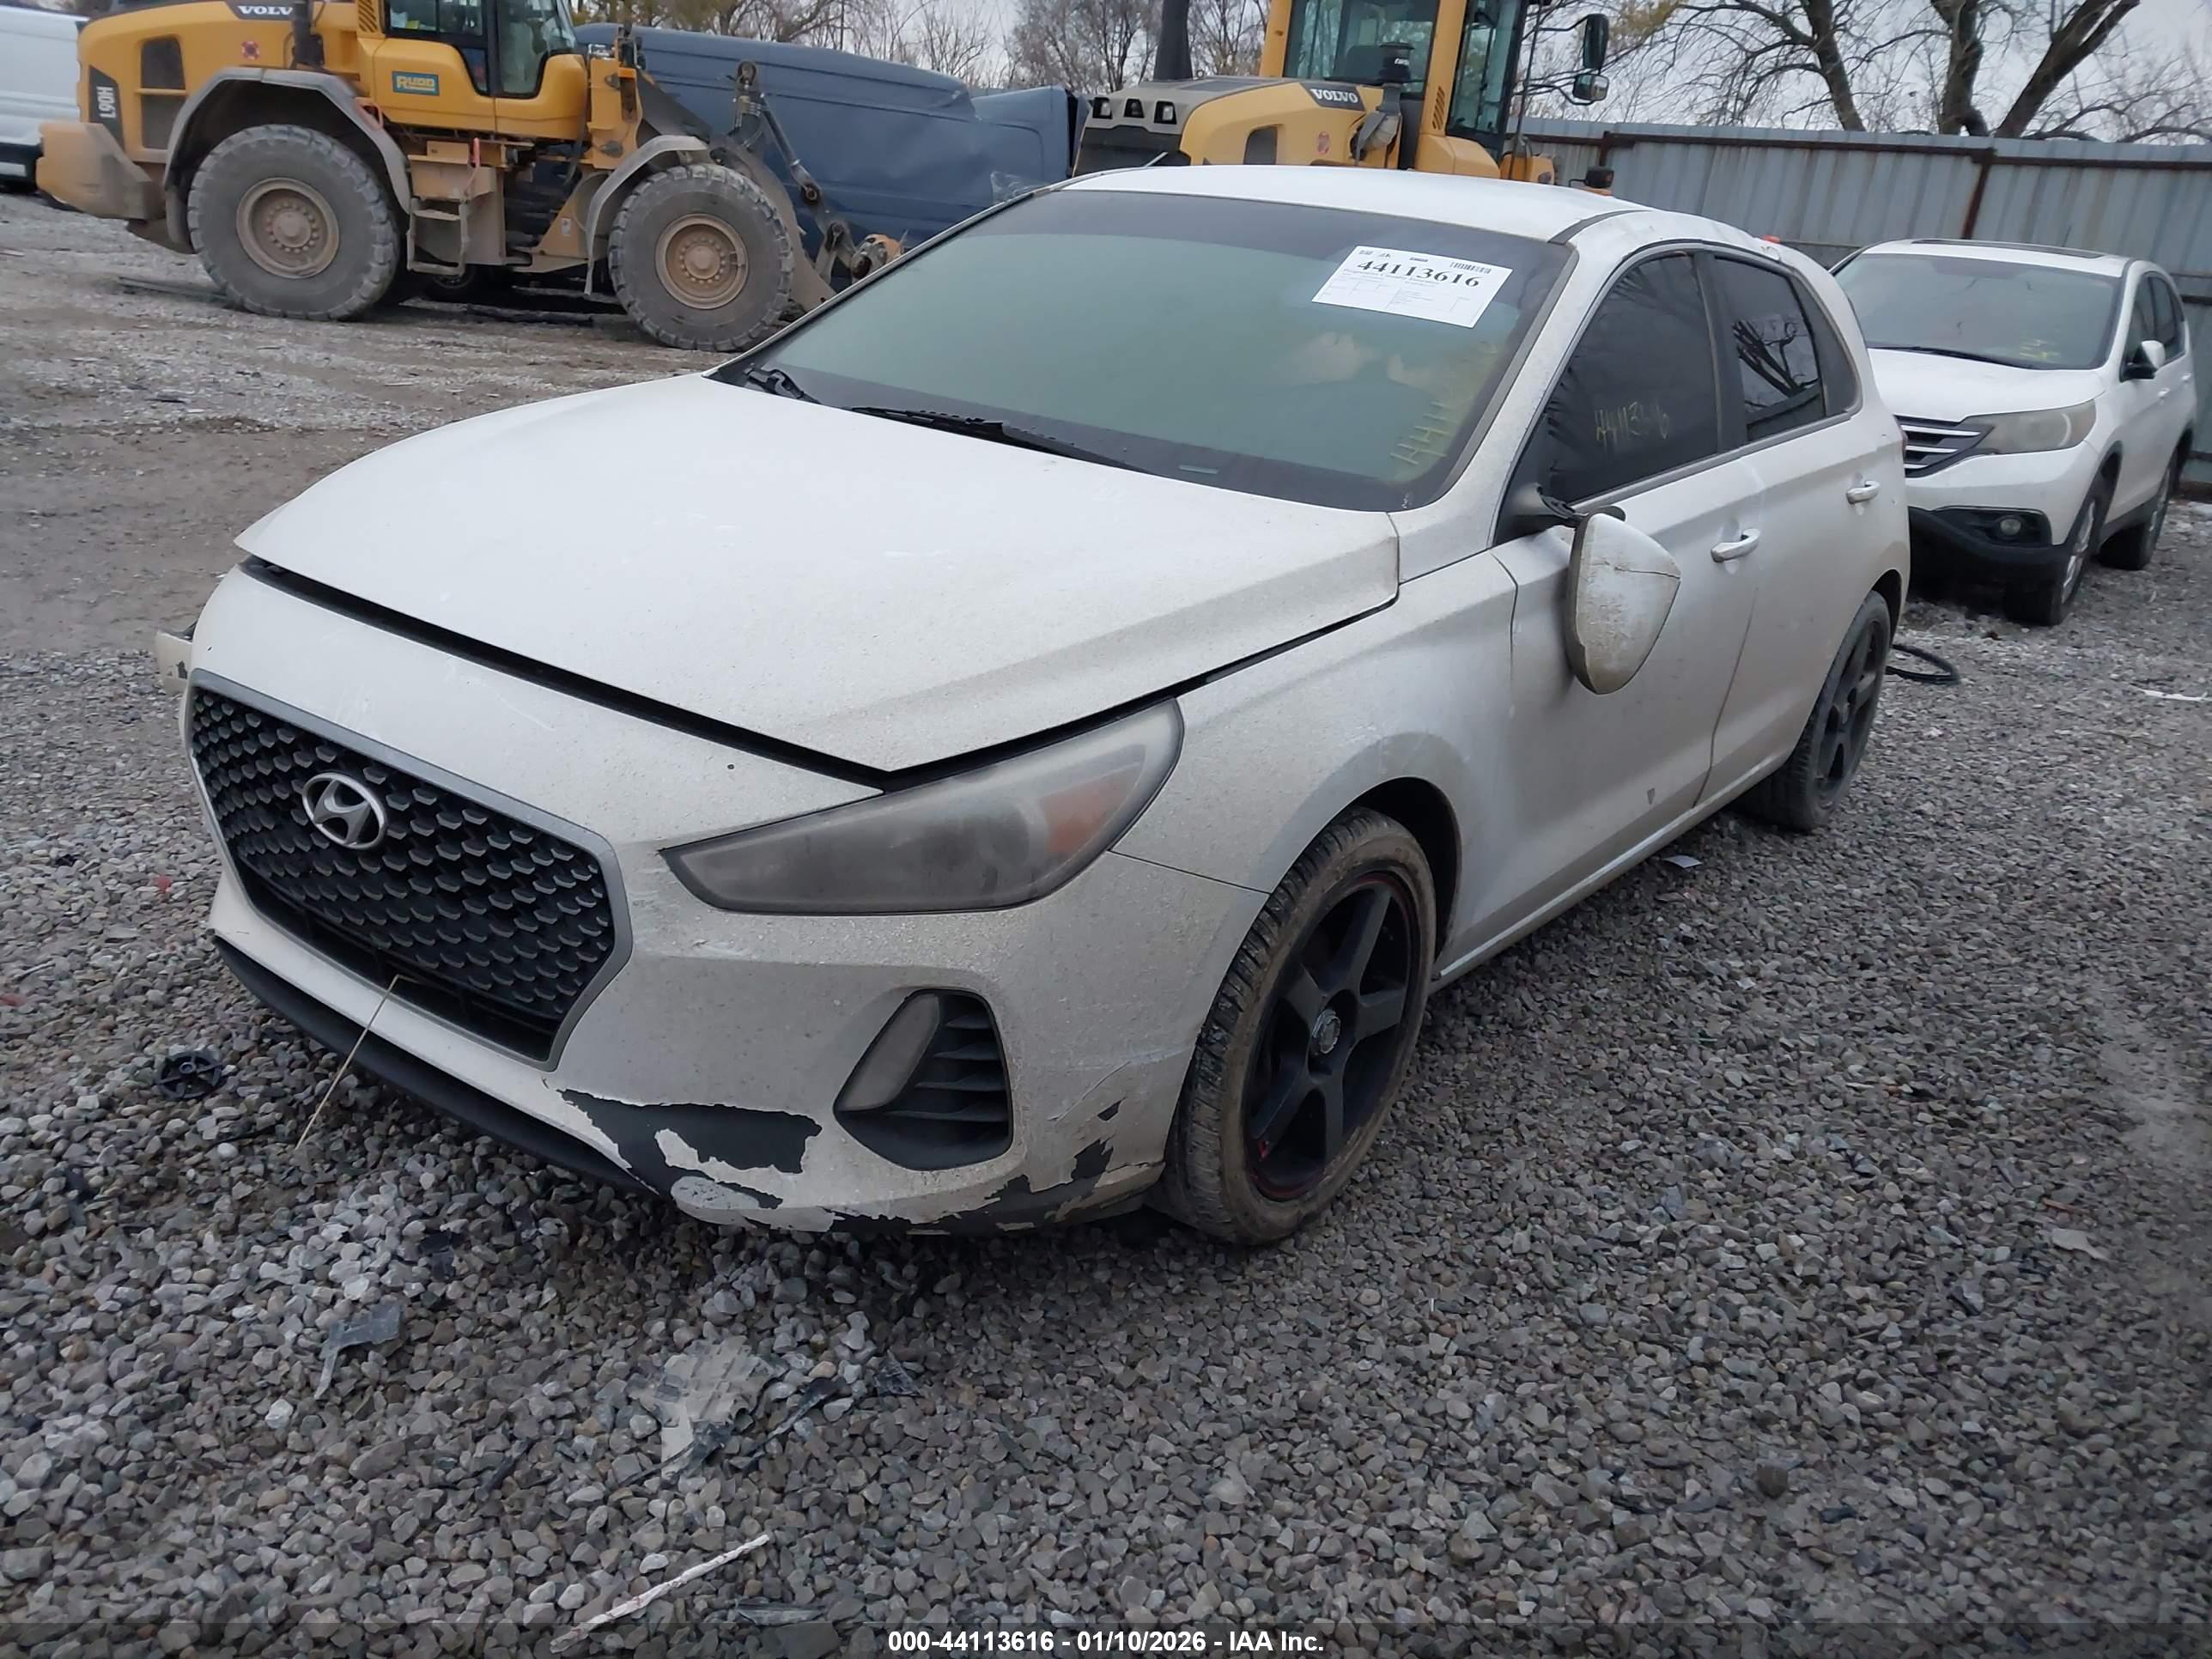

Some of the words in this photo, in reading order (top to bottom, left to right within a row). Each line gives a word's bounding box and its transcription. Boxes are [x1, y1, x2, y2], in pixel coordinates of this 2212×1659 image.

[237, 5, 294, 15] VOLV
[96, 86, 116, 118] L90H
[1310, 88, 1358, 103] VOLVO
[1357, 259, 1483, 288] 44113616
[1594, 399, 1670, 448] 441136
